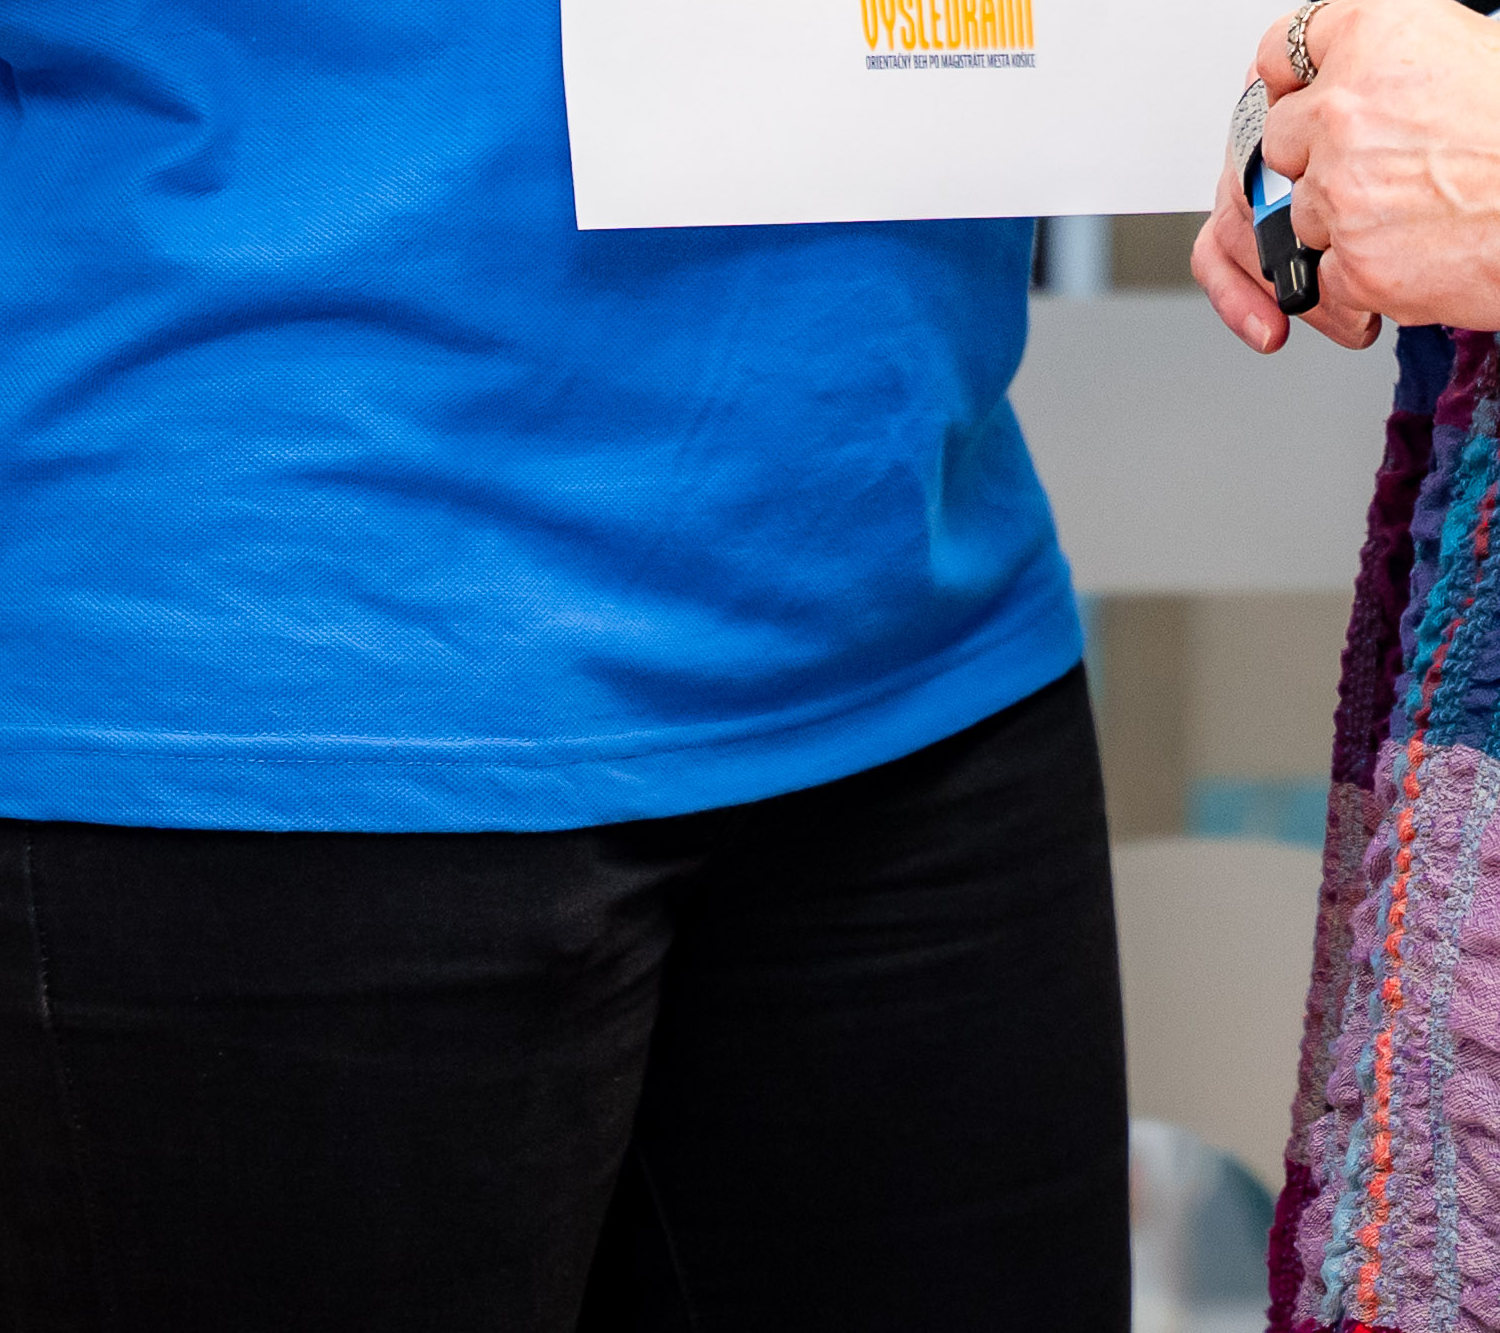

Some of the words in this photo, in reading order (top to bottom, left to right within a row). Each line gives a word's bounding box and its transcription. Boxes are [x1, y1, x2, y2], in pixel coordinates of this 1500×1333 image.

[913, 54, 928, 69] BEH
[929, 54, 940, 69] PO
[987, 53, 1010, 69] MESTA
[1011, 51, 1036, 69] KOŠICE
